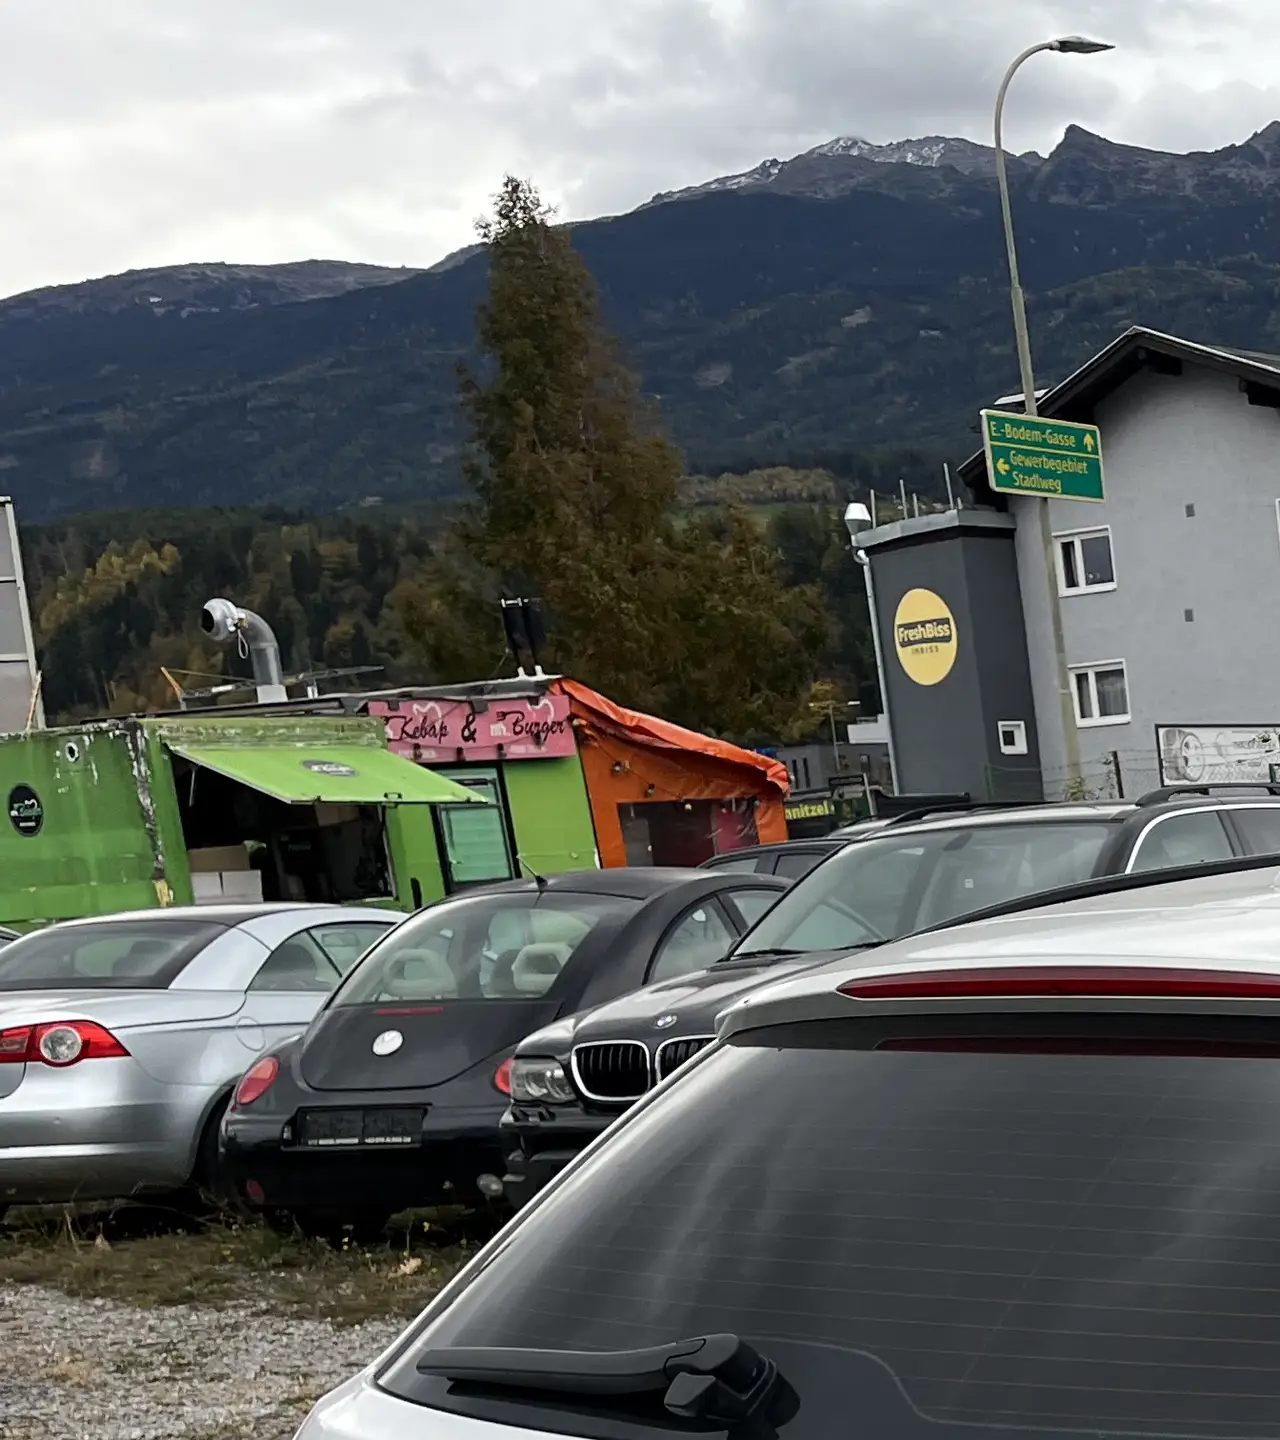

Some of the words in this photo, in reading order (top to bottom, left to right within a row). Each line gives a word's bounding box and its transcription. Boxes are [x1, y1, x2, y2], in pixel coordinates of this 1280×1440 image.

[1009, 450, 1088, 474] Gewerbegebiet
[1012, 471, 1062, 493] Stadlweg
[898, 622, 951, 642] FreshBiss
[396, 714, 449, 745] Kebap
[461, 713, 477, 743] &
[508, 711, 565, 745] Burger
